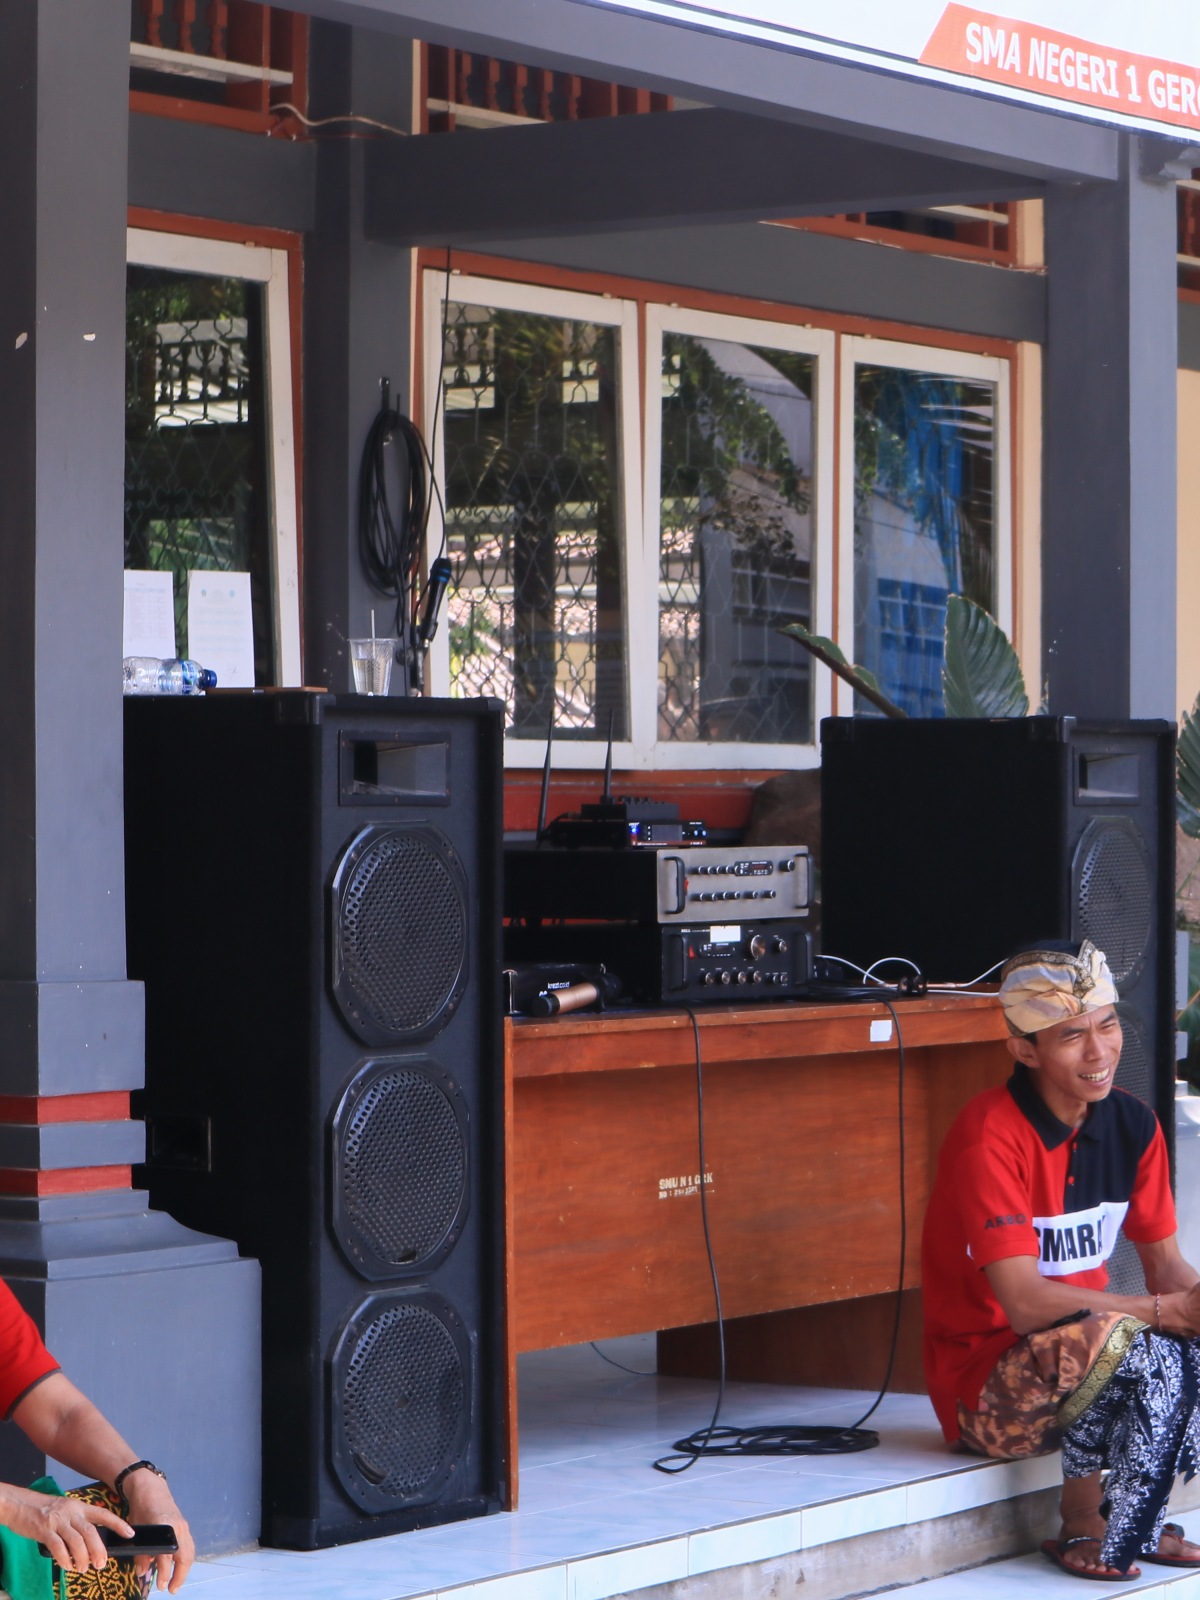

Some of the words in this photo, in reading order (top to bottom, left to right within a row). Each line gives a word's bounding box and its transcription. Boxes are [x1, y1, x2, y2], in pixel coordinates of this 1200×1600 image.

[965, 21, 1021, 74] SMA
[1028, 37, 1120, 98] NEGERI
[1126, 64, 1142, 103] 1
[680, 1175, 687, 1188] N
